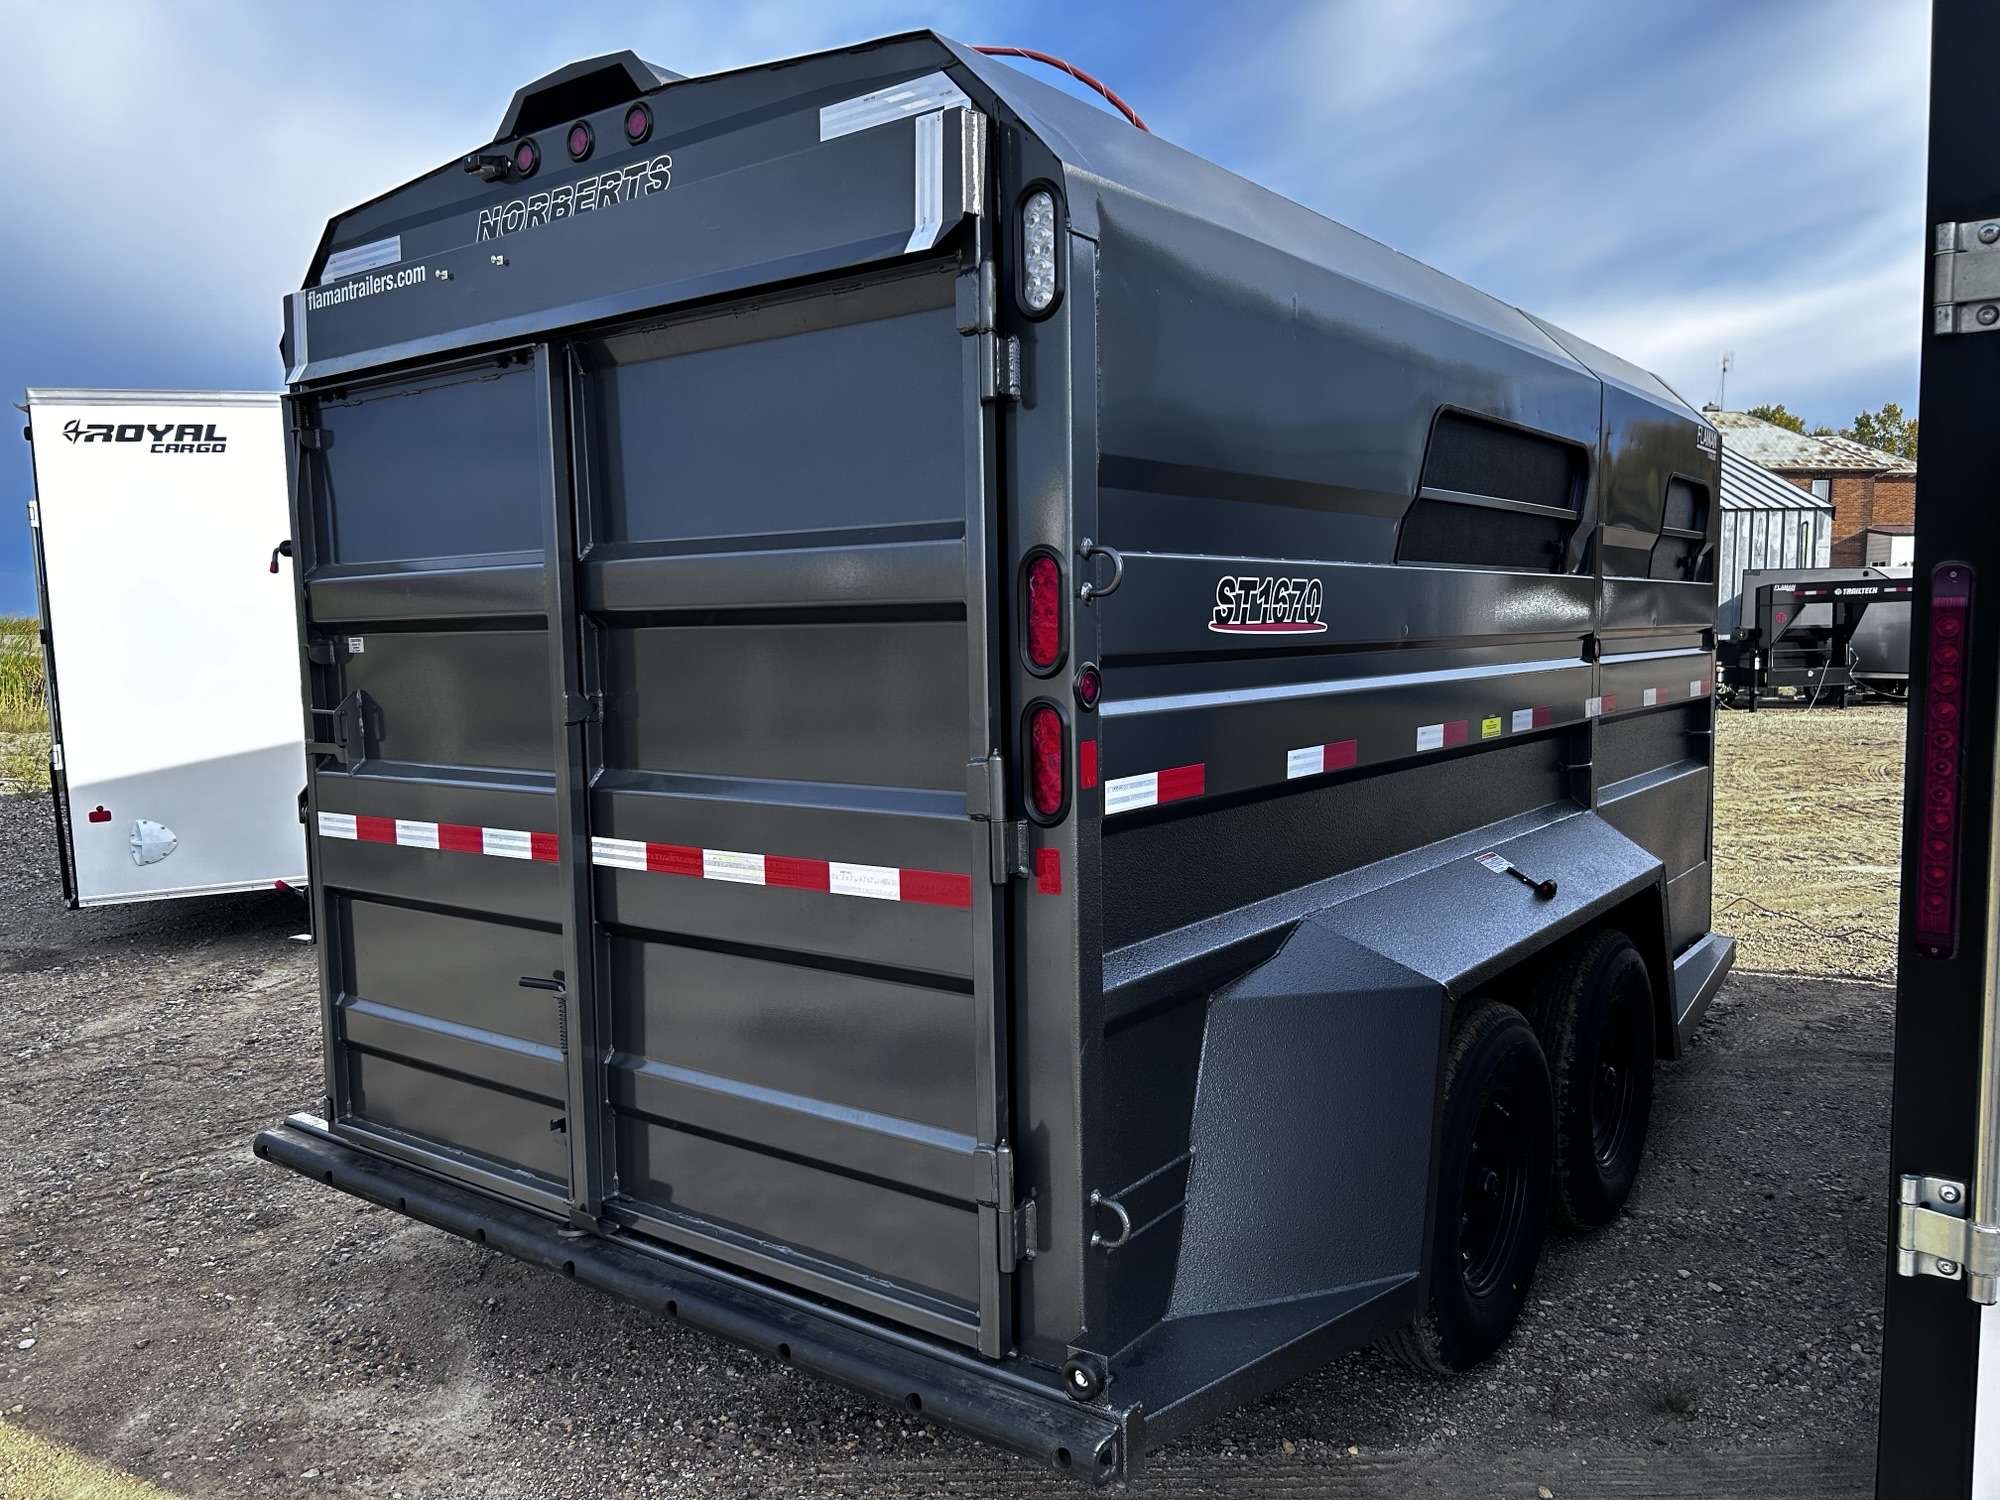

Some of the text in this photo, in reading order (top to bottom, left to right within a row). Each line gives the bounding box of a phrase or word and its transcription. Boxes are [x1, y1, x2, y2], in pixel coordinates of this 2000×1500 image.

[476, 155, 672, 243] NORBERTS
[307, 265, 426, 311] flamantrailers.com
[84, 424, 227, 443] ROYAL
[150, 443, 227, 454] CARGO
[1213, 575, 1323, 625] ST1670
